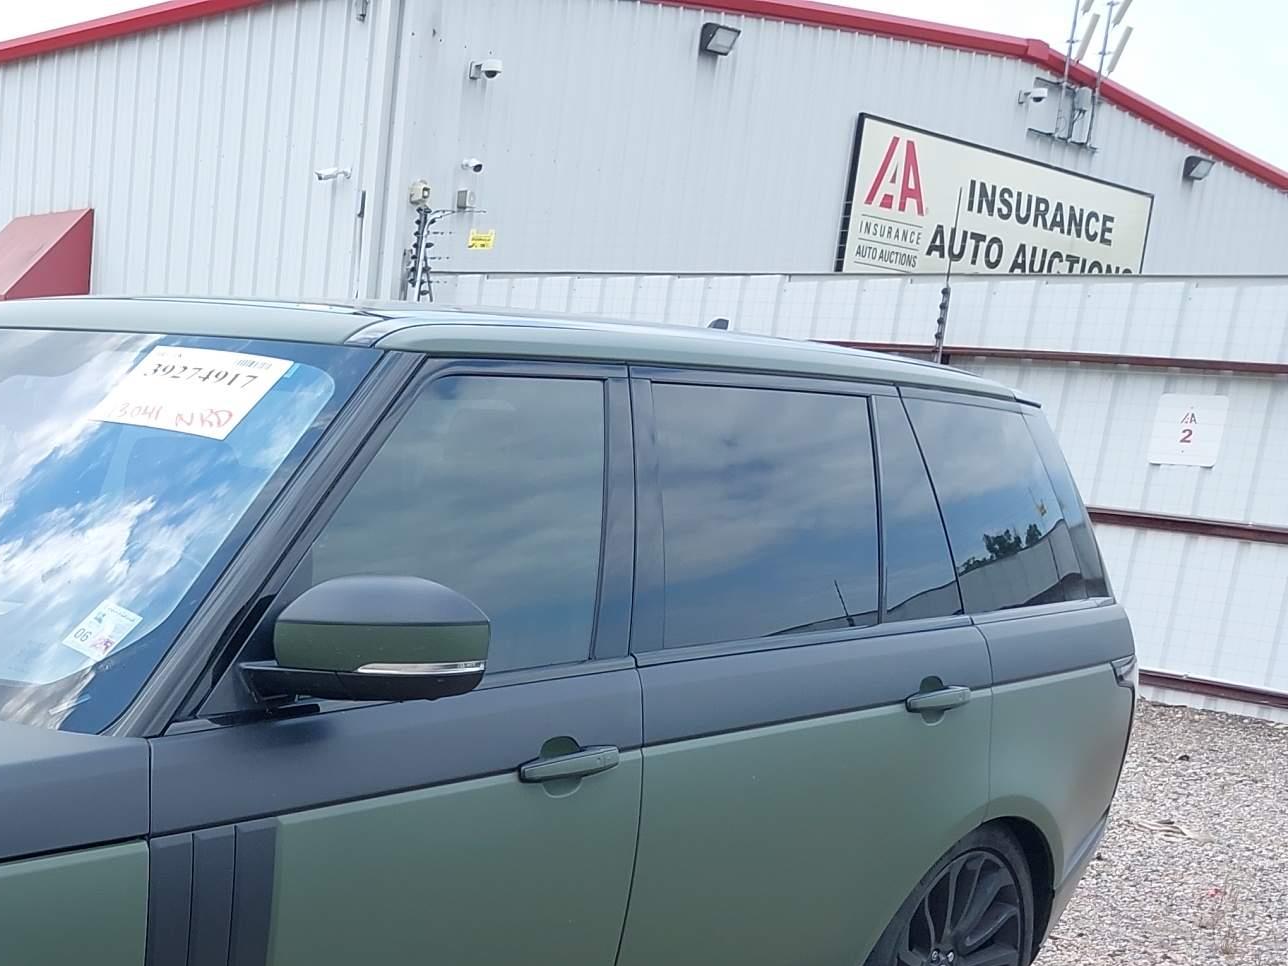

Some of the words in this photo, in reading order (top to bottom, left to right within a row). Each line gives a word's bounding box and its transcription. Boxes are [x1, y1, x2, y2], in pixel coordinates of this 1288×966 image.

[966, 179, 1115, 247] INSURANCE
[859, 220, 922, 246] INSURANCE
[855, 244, 877, 261] AUTO
[878, 247, 918, 269] AUCTIONS
[925, 223, 1004, 270] AUTO
[1009, 243, 1134, 274] AUCTI
[143, 361, 259, 389] 39274917
[1179, 428, 1193, 444] 2
